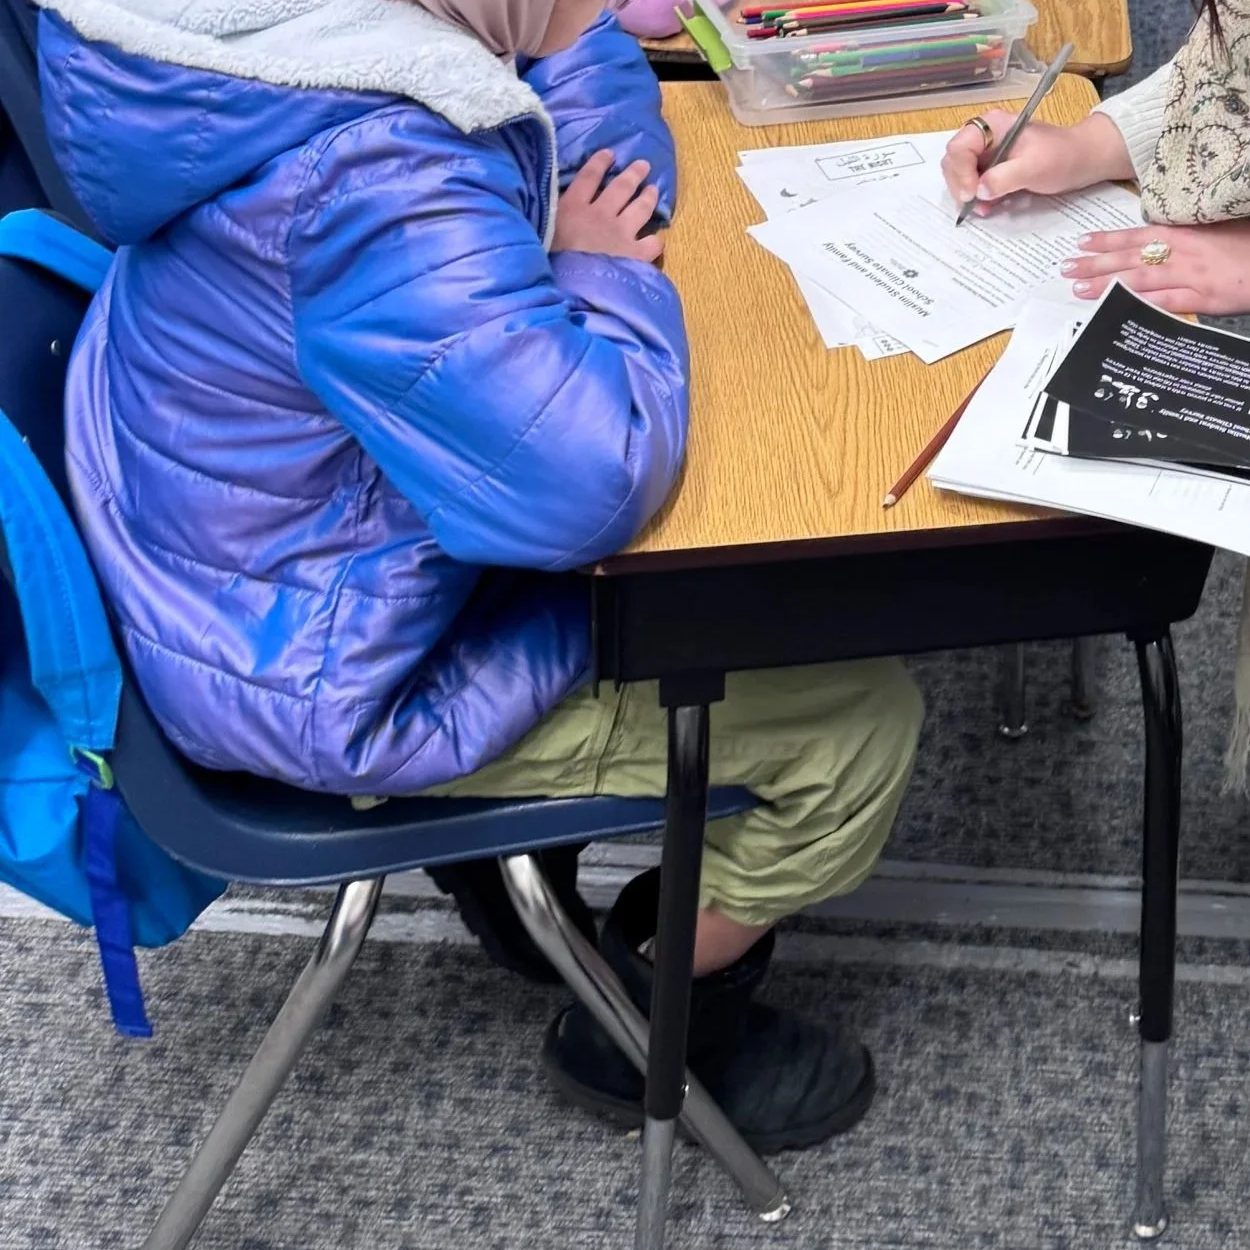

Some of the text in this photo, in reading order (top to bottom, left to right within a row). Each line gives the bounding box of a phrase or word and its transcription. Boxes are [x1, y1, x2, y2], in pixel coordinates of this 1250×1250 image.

[822, 242, 931, 317] Muslim Student and Family
[844, 242, 934, 305] School Climate Survey
[1159, 409, 1184, 420] Family
[1180, 408, 1205, 419] Survey
[1183, 415, 1199, 423] and
[1198, 420, 1227, 433] Student
[1205, 415, 1233, 428] Climate
